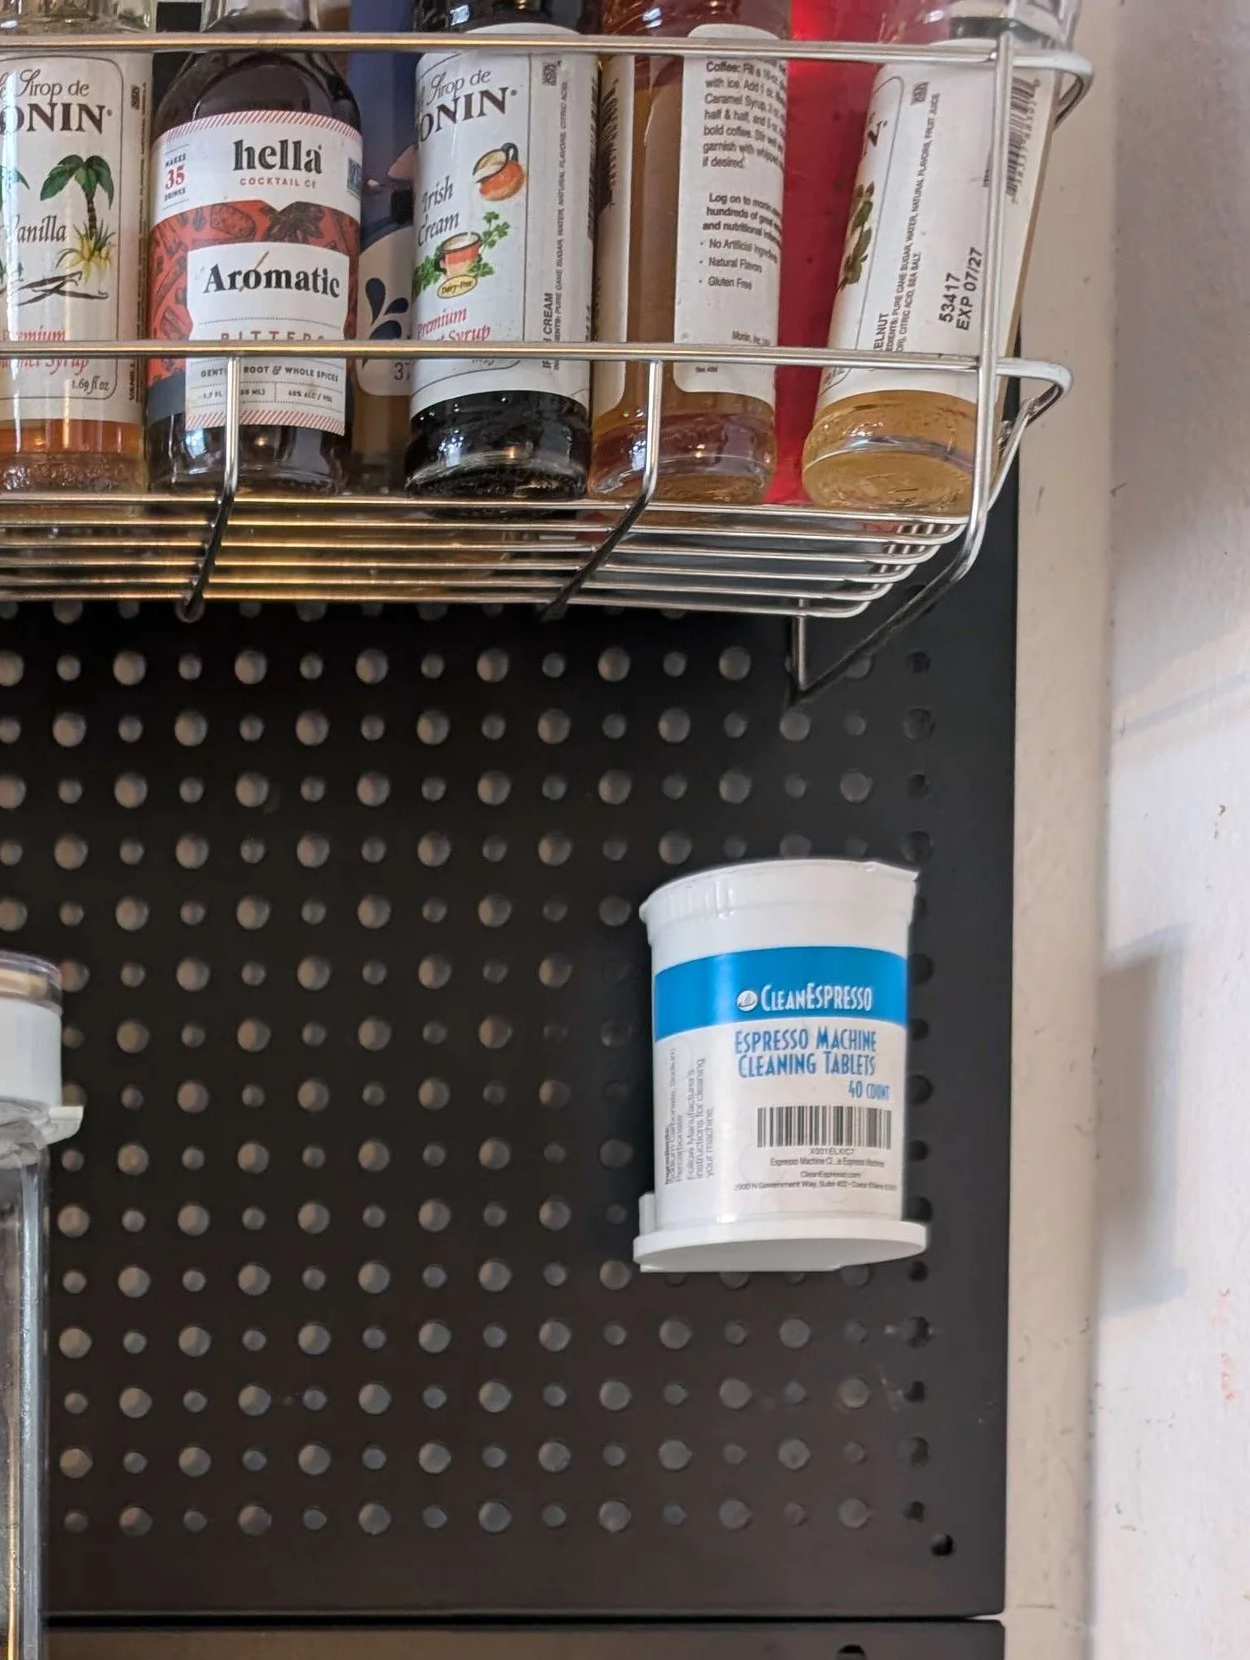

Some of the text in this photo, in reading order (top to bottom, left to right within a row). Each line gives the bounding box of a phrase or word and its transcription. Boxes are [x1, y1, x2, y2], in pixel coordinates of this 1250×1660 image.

[17, 69, 63, 103] Sirop
[68, 79, 90, 96] de
[427, 71, 465, 106] Sirop
[470, 69, 492, 85] de
[232, 138, 322, 174] hella
[165, 164, 186, 190] 35
[239, 177, 300, 187] COCKTAIL
[422, 175, 454, 213] Irish
[709, 192, 751, 206] Log on to
[912, 178, 924, 212] NATURAL
[706, 206, 748, 218] hundreds
[750, 212, 758, 220] of
[418, 211, 460, 246] Cream
[702, 221, 721, 230] and
[723, 222, 762, 236] nutritional
[709, 238, 722, 249] No
[708, 256, 738, 268] Natural
[203, 263, 340, 299] Aromatic
[708, 276, 752, 290] Gluten Free
[956, 246, 983, 331] EXP 07/27
[904, 289, 916, 310] ACID,
[938, 272, 962, 323] 53417
[417, 308, 468, 341] Premium
[542, 292, 554, 335] CREAM
[900, 310, 910, 334] CITRIC
[448, 324, 492, 342] Syrup
[243, 366, 270, 375] ROOT
[272, 365, 282, 376] &
[284, 366, 314, 378] WHOLE
[760, 982, 872, 1012] CLEANESPRESSO
[734, 1025, 876, 1054] ESPRESSO MACHINE
[738, 1052, 876, 1078] CLEANING TABLETS
[848, 1080, 890, 1102] 40 COUNT
[695, 1058, 706, 1178] instructions for cleaning
[676, 1115, 684, 1182] Percarbonate
[686, 1148, 695, 1180] Follow
[706, 1156, 714, 1178] your
